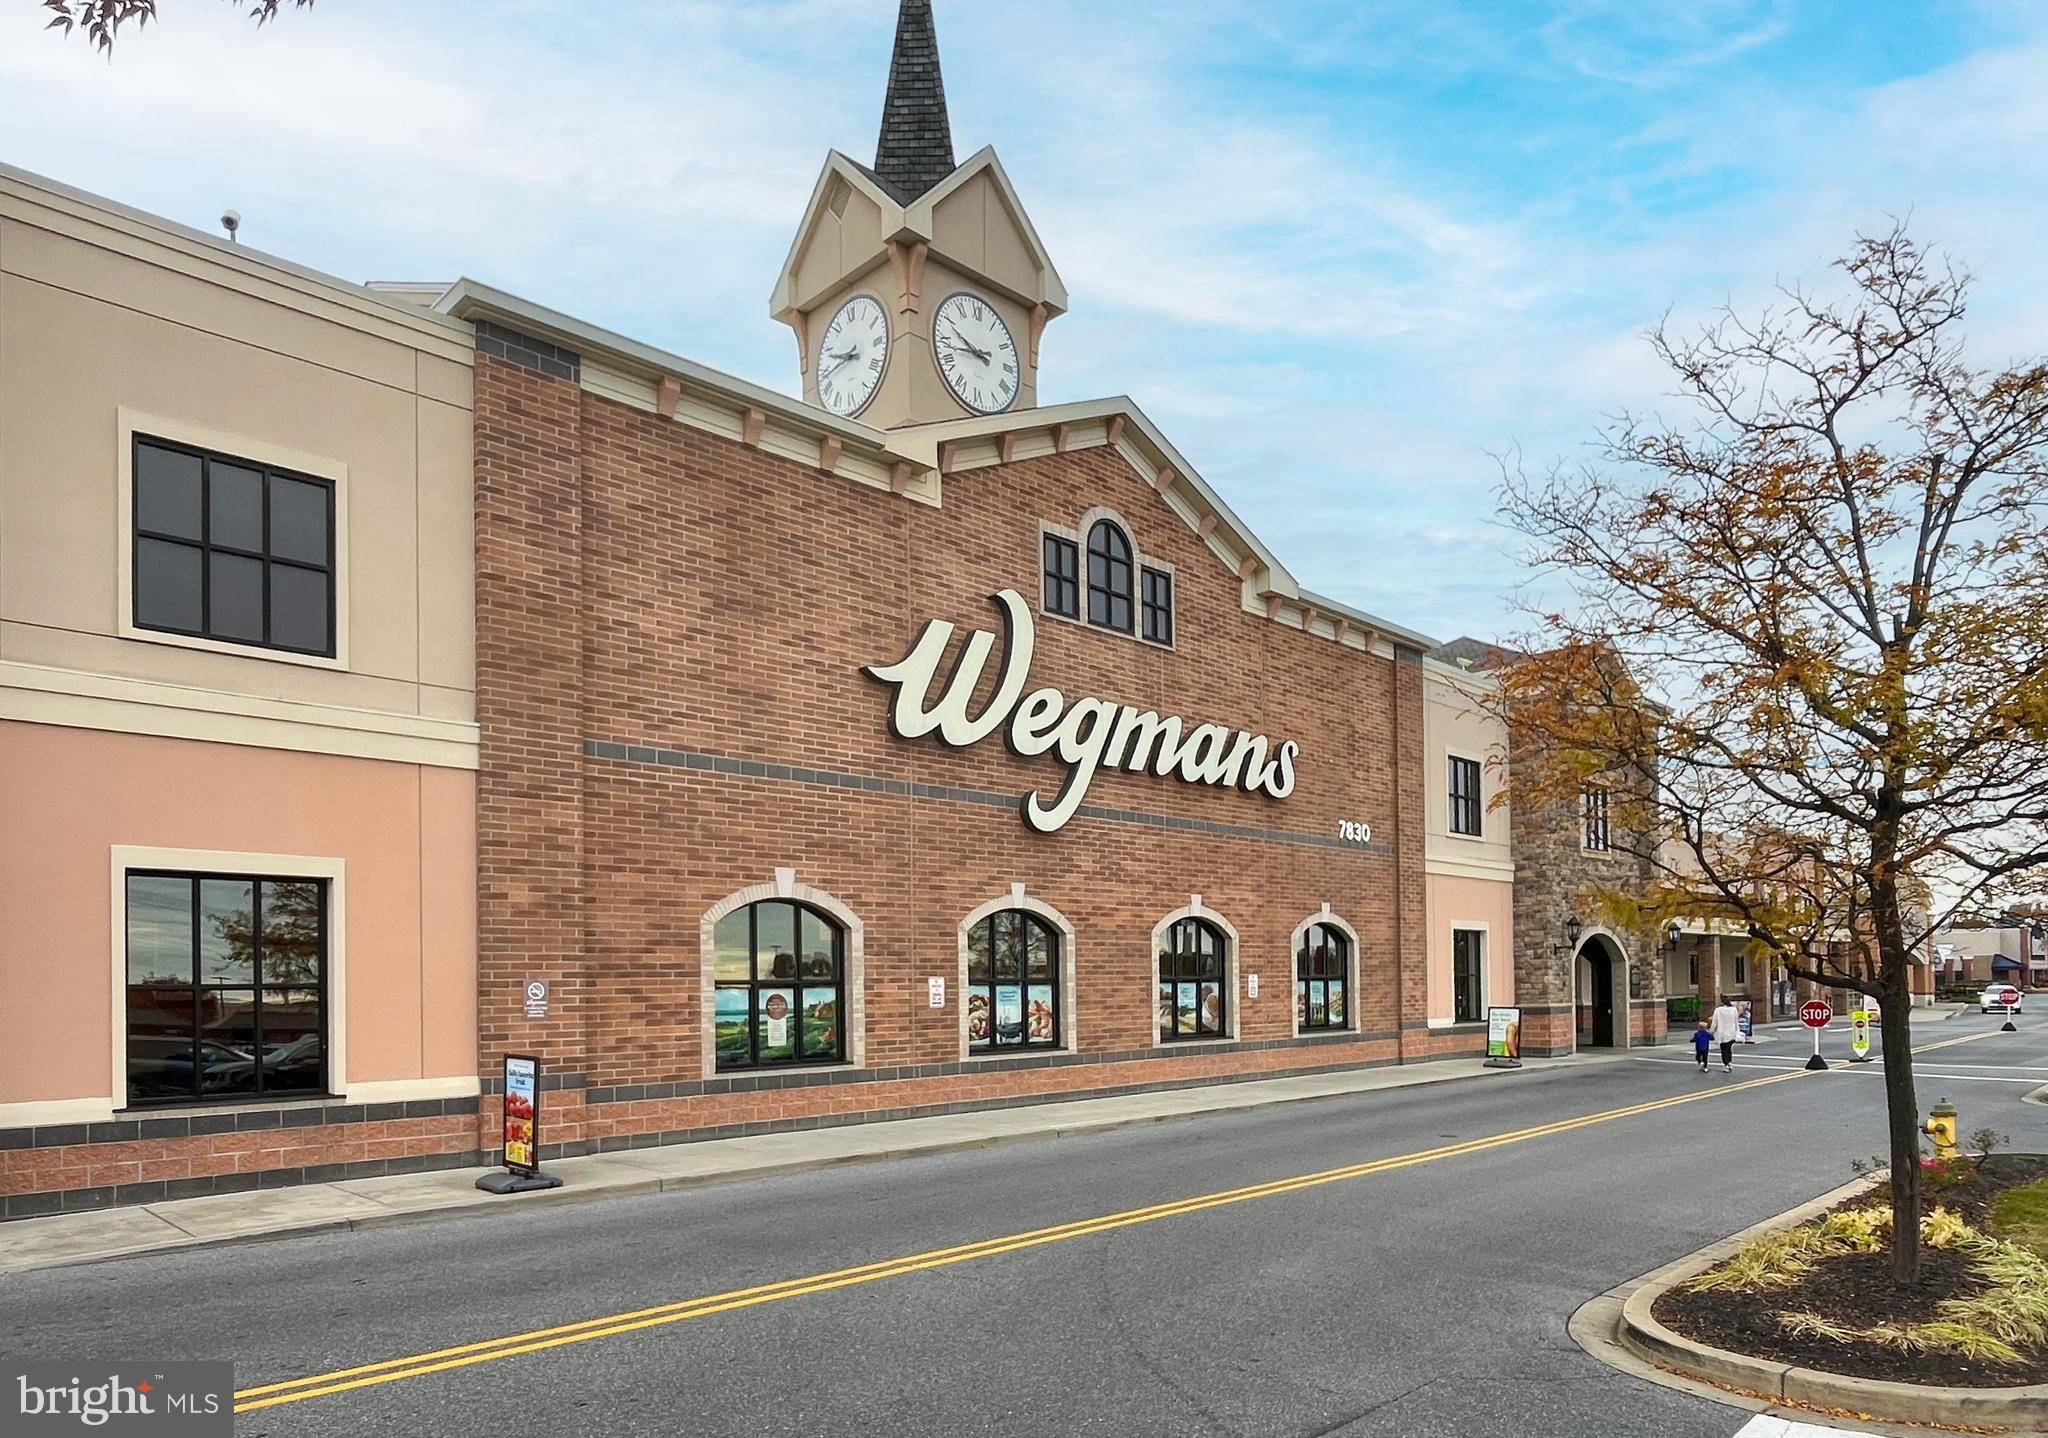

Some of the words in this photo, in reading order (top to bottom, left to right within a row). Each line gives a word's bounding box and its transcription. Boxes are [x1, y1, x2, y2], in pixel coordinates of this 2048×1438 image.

[861, 588, 1299, 833] Wegmans
[1338, 819, 1371, 842] 7830
[1802, 1008, 1830, 1020] STOP
